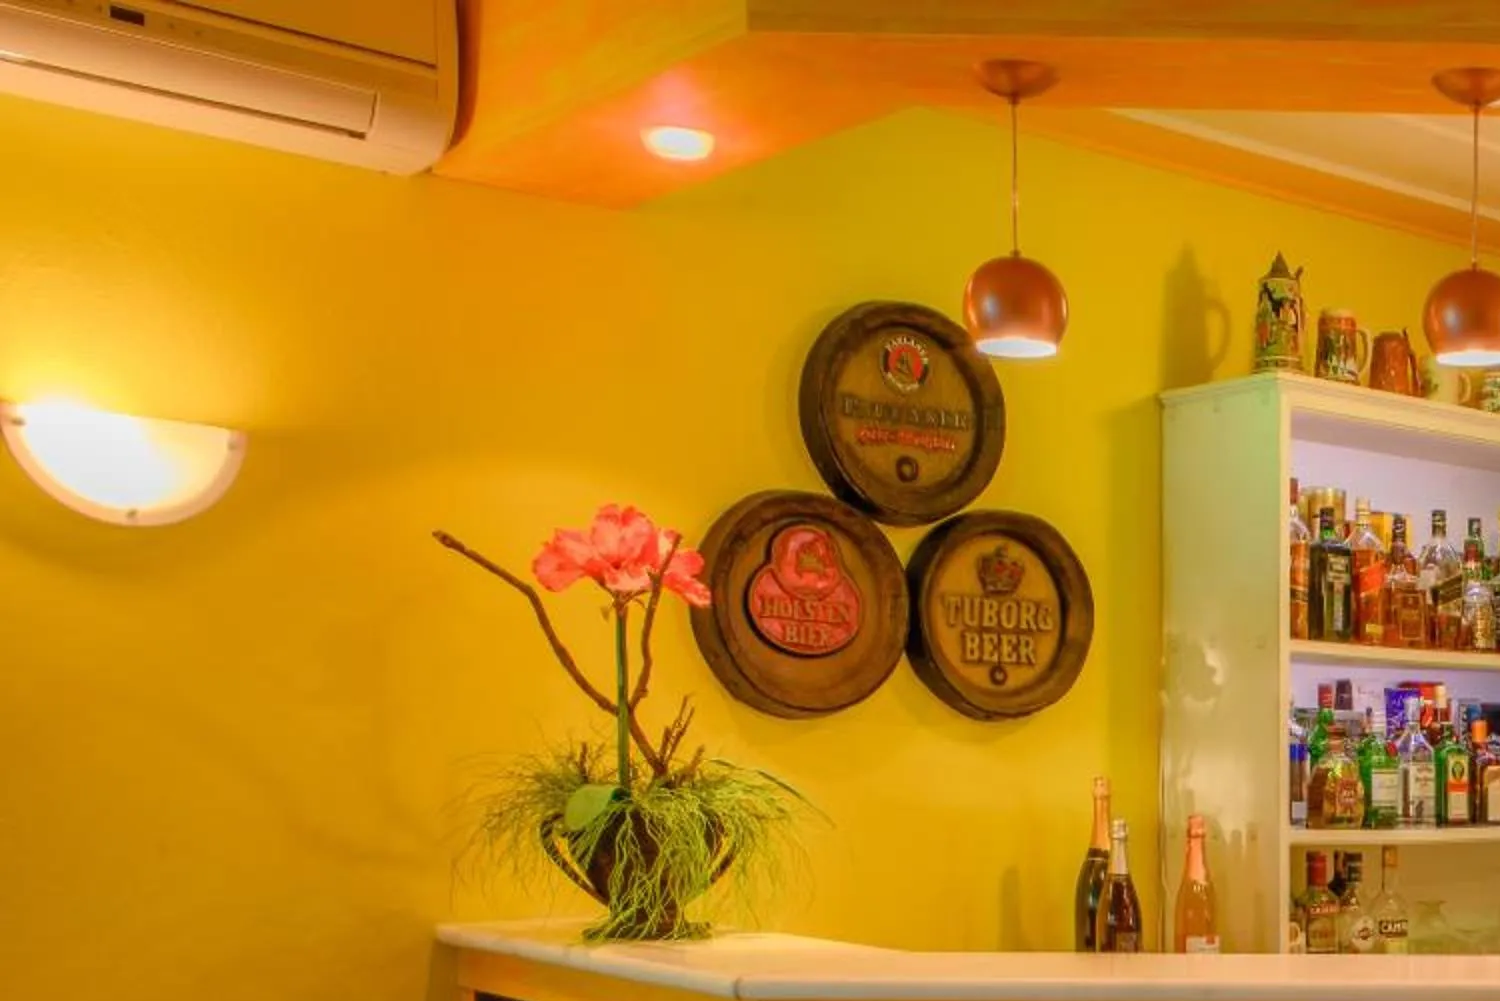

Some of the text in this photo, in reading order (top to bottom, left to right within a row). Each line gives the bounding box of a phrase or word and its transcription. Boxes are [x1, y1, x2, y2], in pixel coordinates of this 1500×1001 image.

[759, 596, 850, 623] HOLSTEN
[945, 596, 1054, 631] TUBORG
[784, 622, 830, 648] BIER
[964, 631, 1036, 664] BEER
